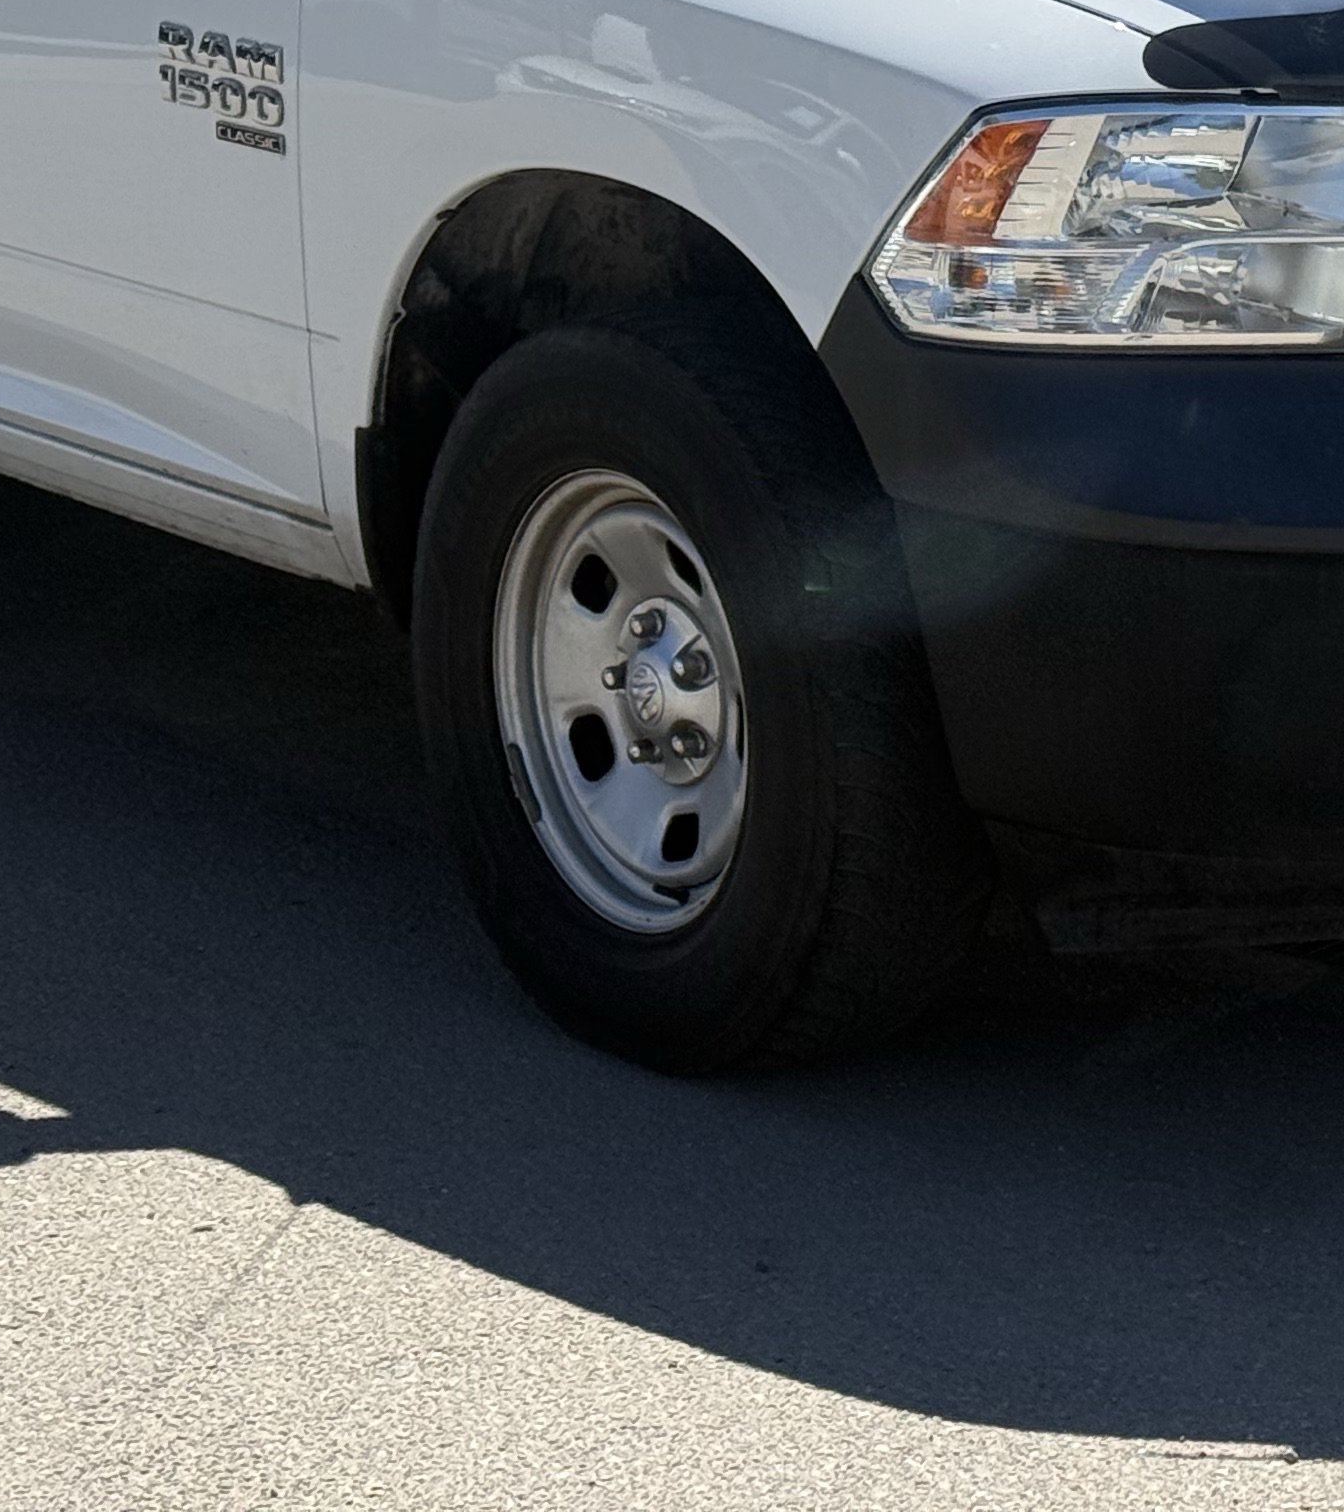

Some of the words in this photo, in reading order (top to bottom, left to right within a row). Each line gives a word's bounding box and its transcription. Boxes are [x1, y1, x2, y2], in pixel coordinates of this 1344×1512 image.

[158, 20, 285, 85] RAM
[158, 64, 285, 128] 1500
[216, 124, 283, 153] CLASSIC
